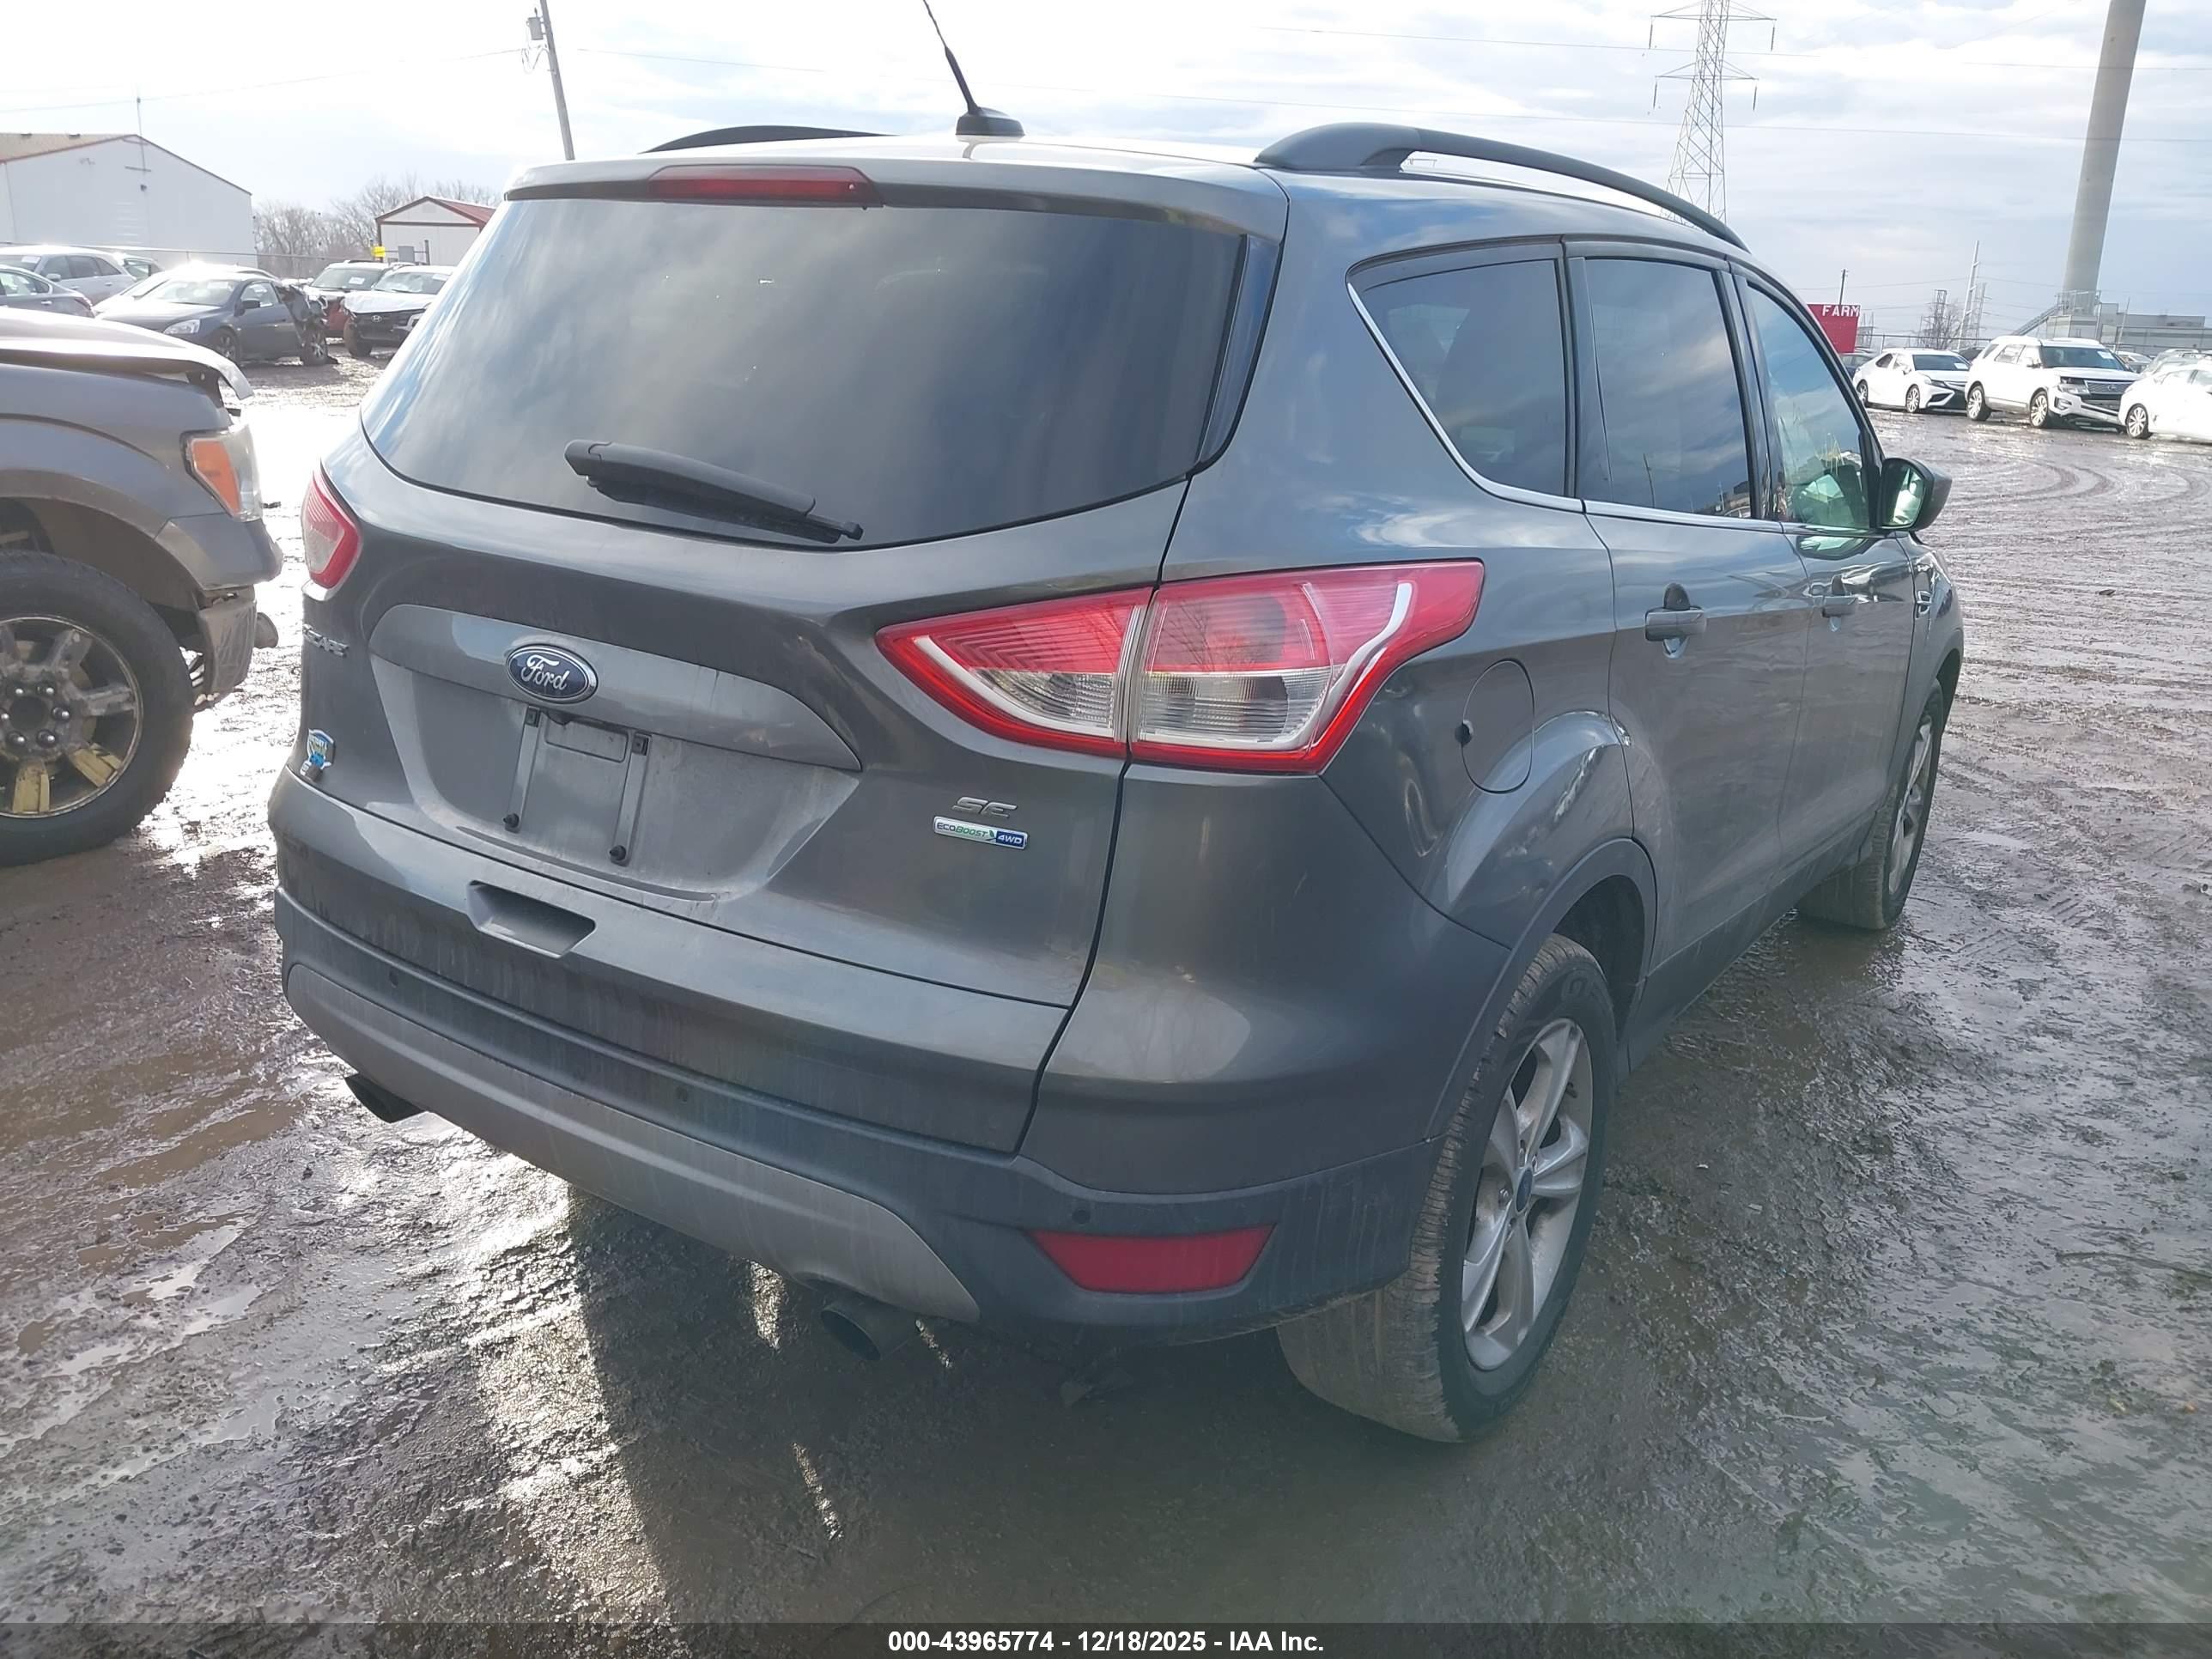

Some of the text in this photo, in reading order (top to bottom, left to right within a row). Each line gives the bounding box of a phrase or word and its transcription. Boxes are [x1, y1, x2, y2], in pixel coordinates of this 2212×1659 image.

[1822, 305, 1860, 317] FARM
[520, 654, 570, 690] Ford
[951, 796, 1018, 817] SE
[998, 834, 1023, 845] 4WD
